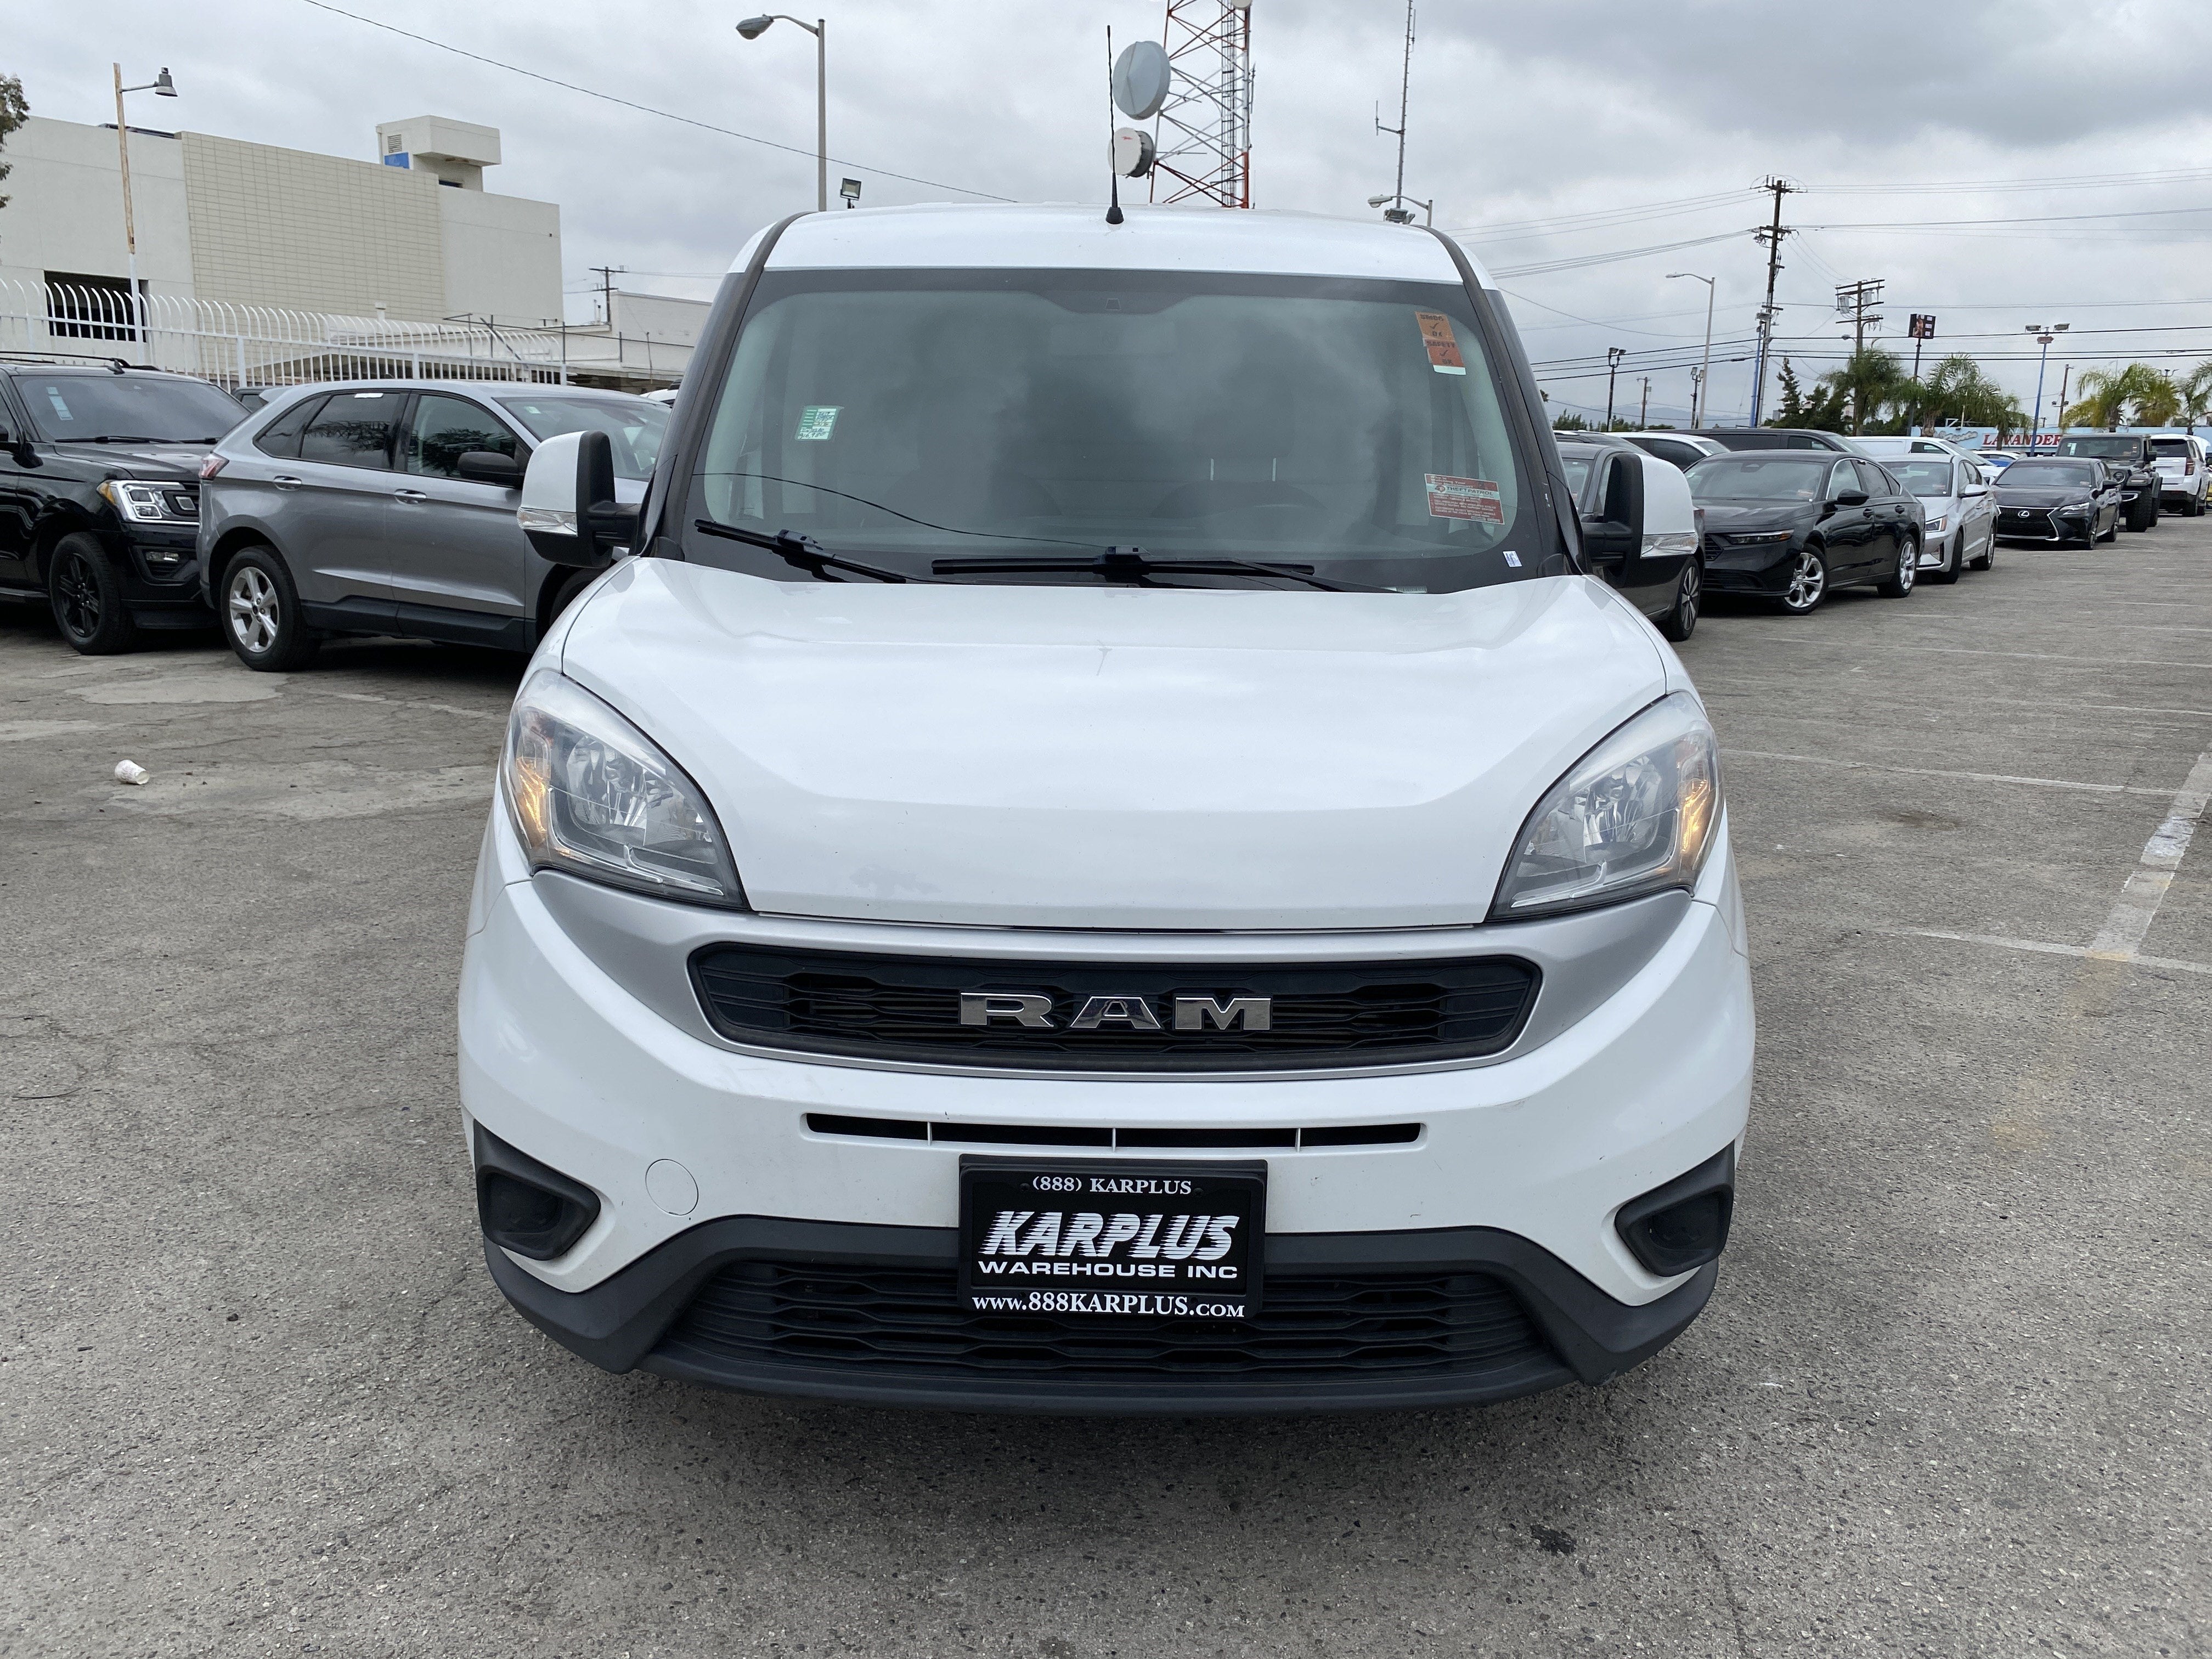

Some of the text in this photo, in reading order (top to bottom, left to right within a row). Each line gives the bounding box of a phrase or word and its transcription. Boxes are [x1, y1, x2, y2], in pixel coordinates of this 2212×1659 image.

[960, 992, 1272, 1030] RAM
[1032, 1176, 1192, 1195] (888) KARPLUS
[978, 1211, 1240, 1261] KARPLUS
[978, 1261, 1238, 1279] WAREHOUSE INC
